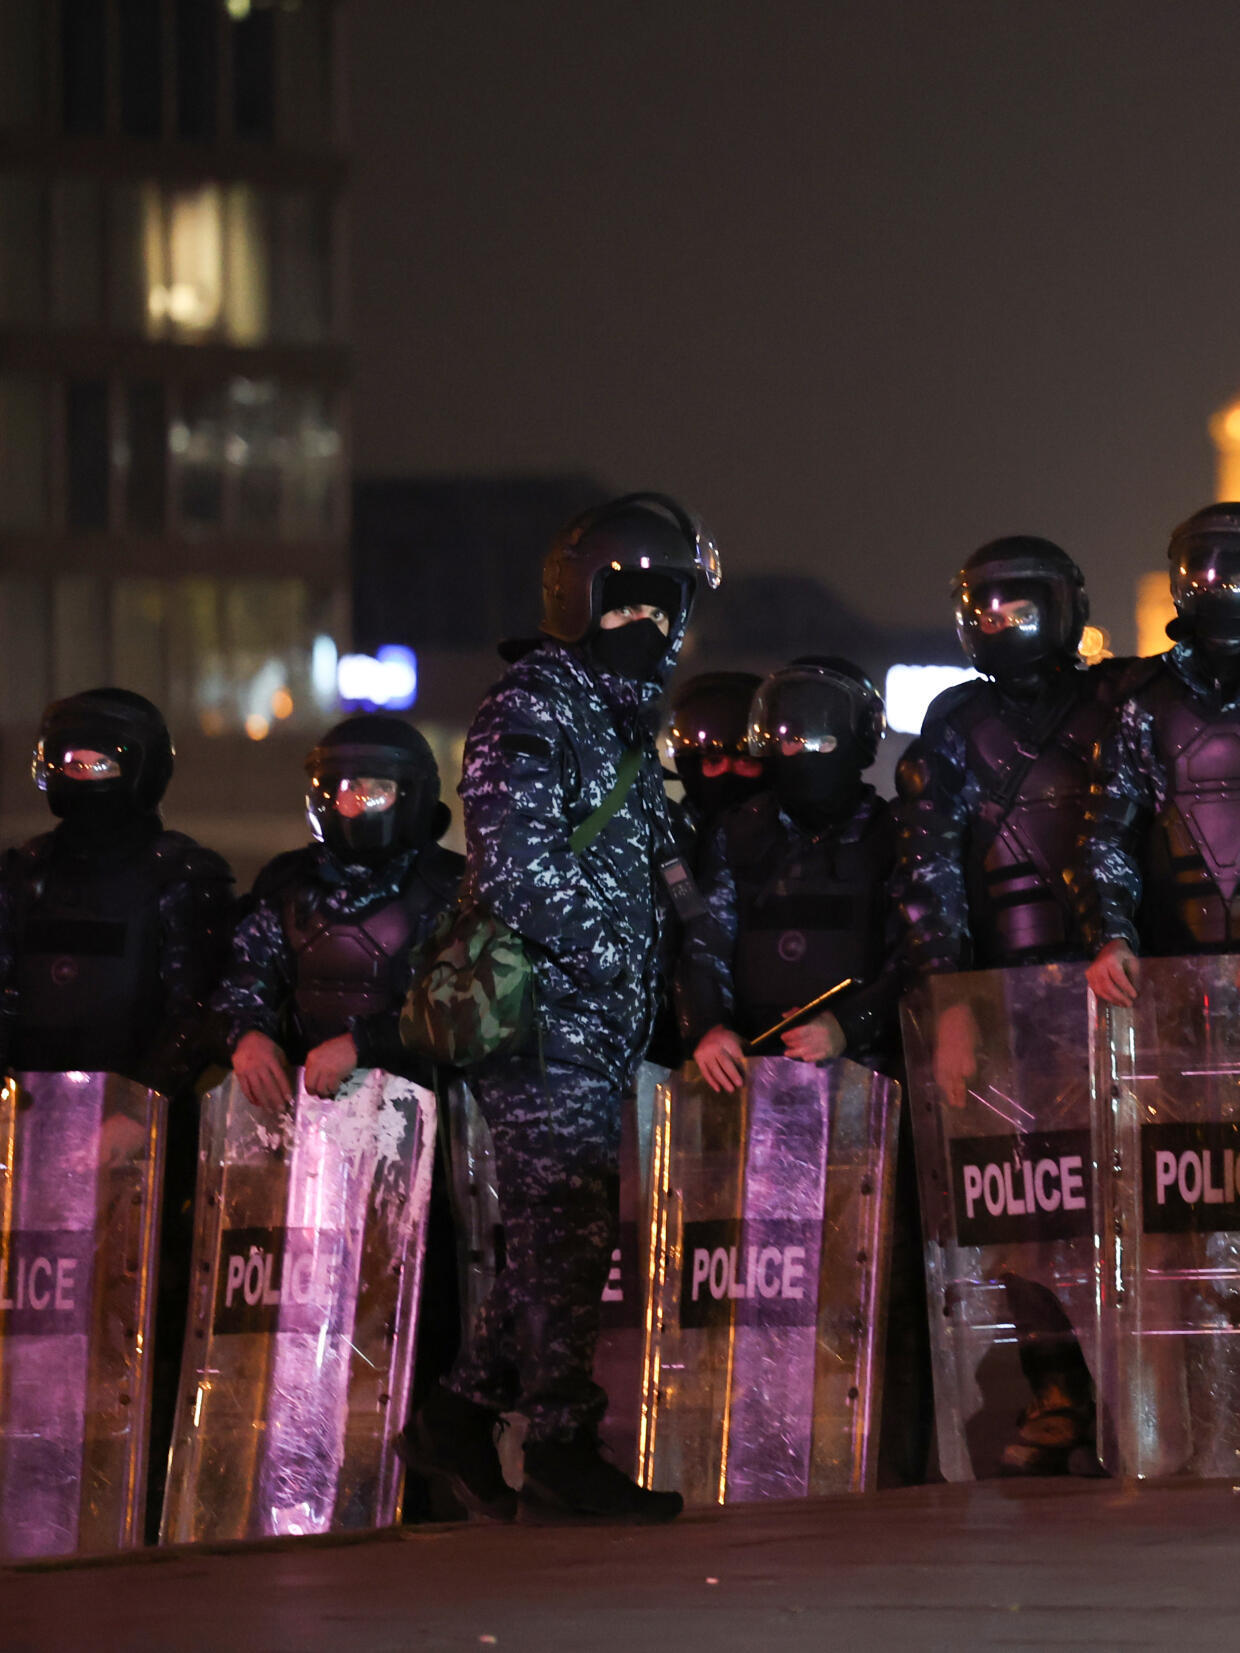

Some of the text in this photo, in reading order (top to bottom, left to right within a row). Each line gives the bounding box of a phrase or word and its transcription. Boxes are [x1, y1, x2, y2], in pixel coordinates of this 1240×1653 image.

[962, 1156, 1086, 1219] POLICE
[0, 1256, 78, 1311] LICE
[692, 1246, 806, 1301] POLICE
